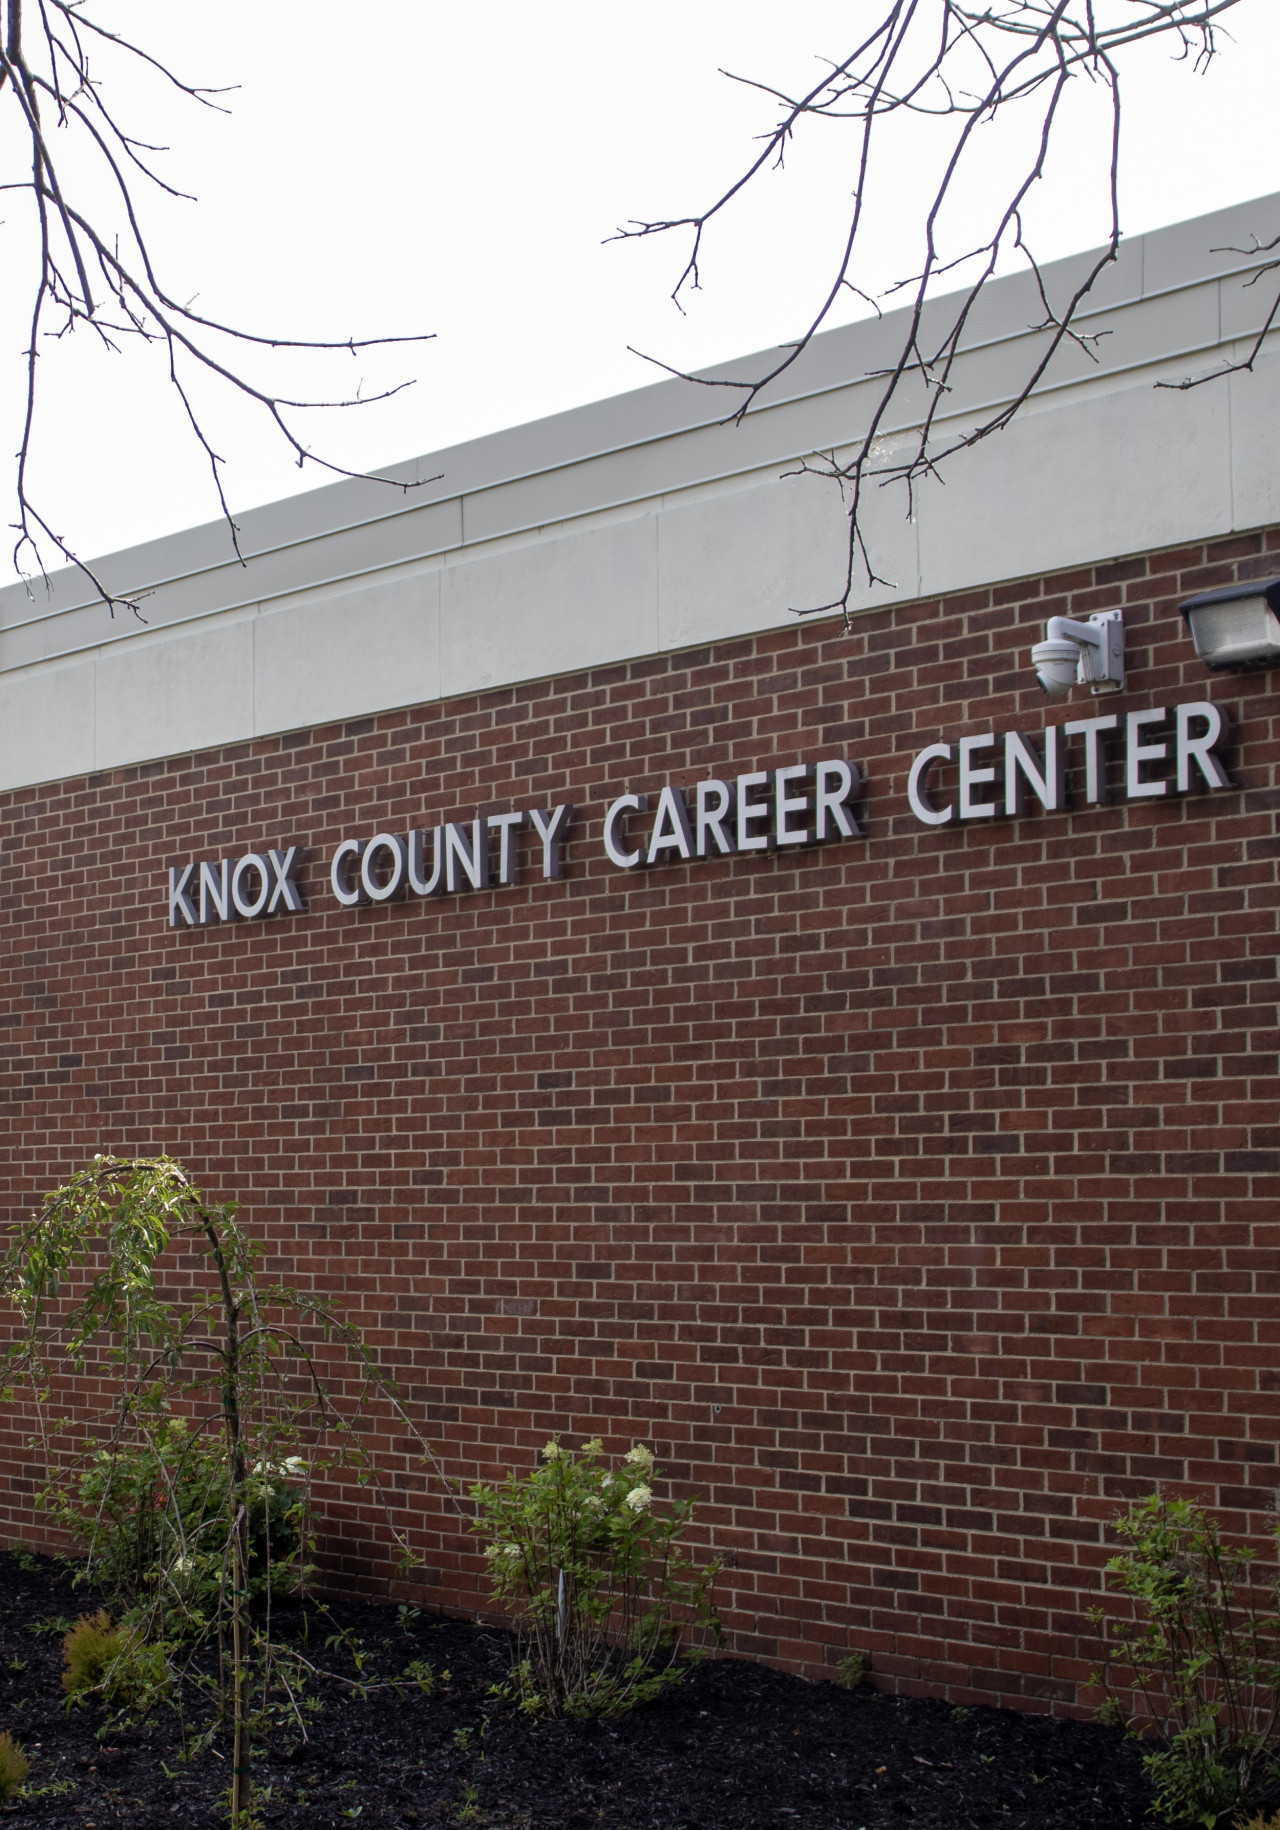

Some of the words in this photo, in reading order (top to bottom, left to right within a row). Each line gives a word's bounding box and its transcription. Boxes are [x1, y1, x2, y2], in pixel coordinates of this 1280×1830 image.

[169, 846, 303, 927] KNOX
[331, 804, 572, 905] COUNTY
[603, 759, 863, 867] CAREER
[907, 701, 1230, 825] CENTER
